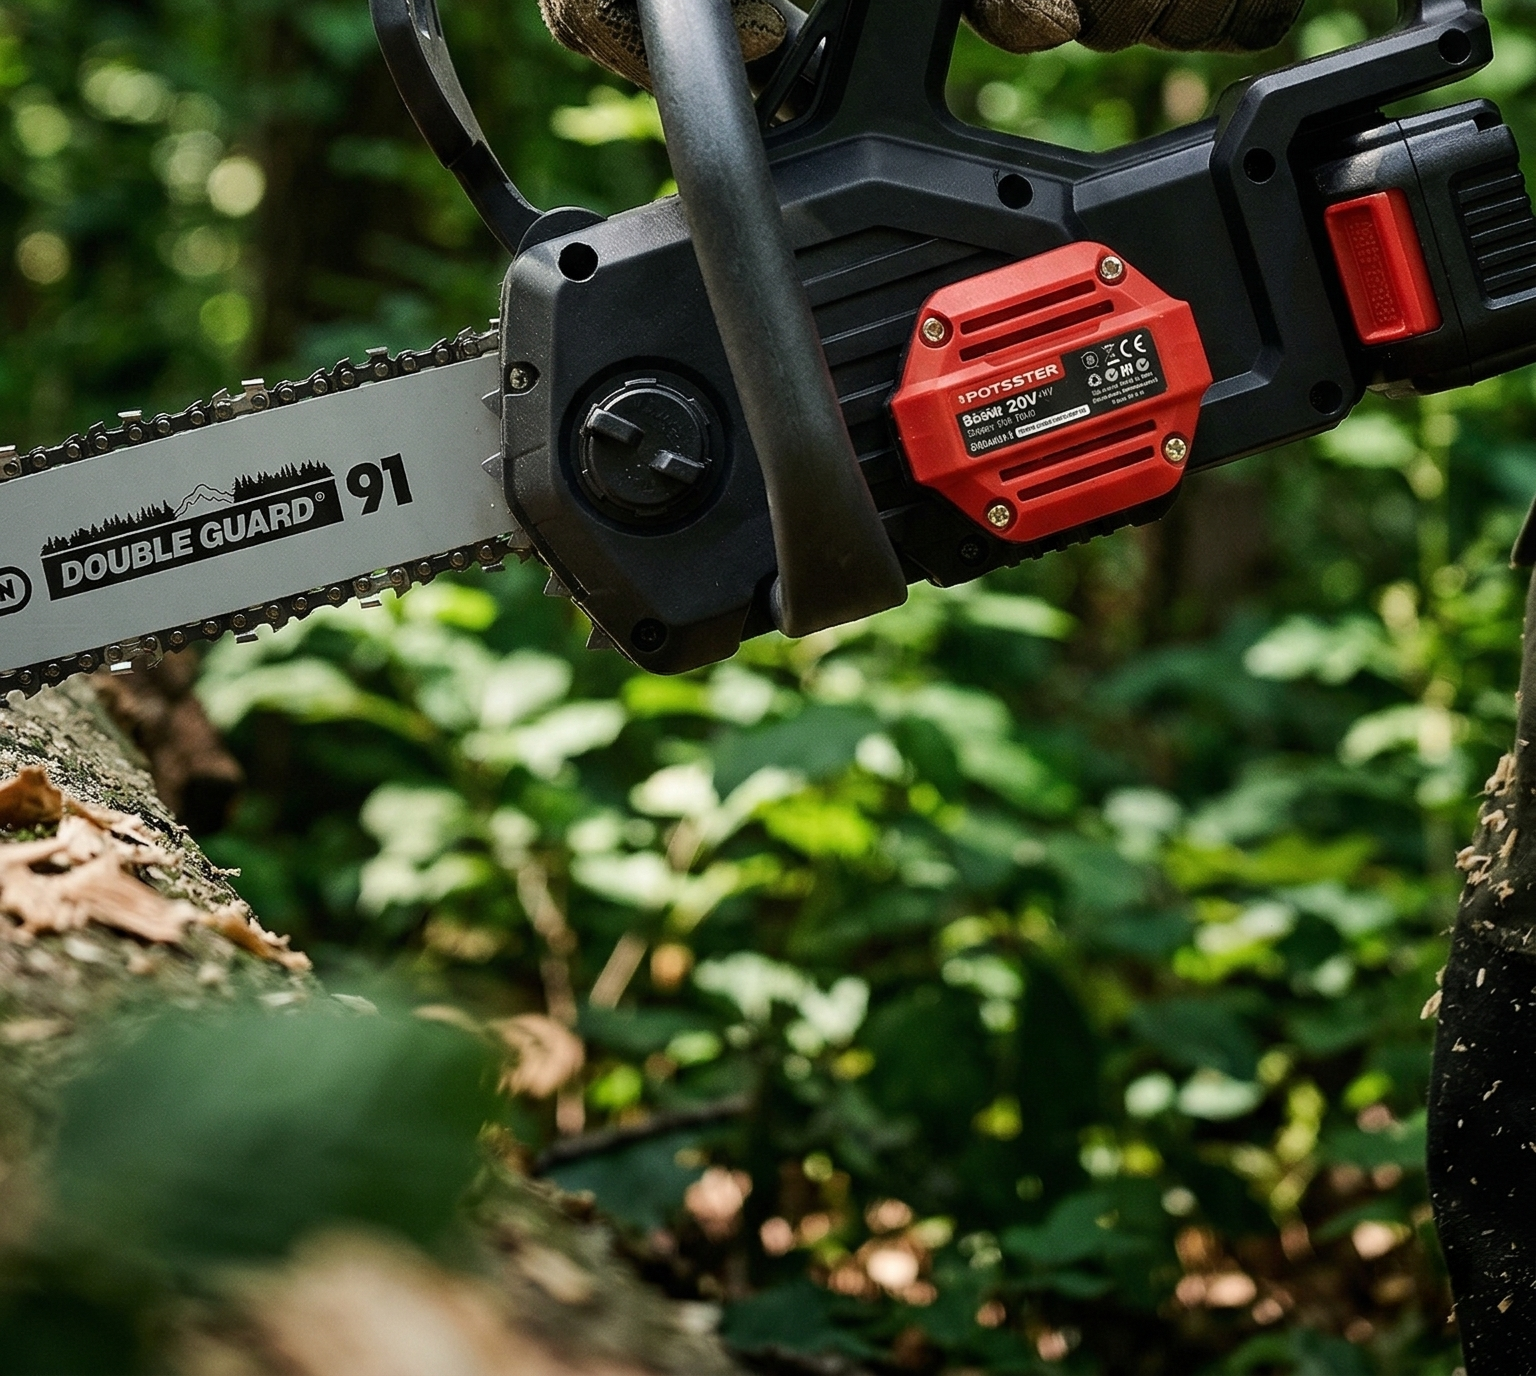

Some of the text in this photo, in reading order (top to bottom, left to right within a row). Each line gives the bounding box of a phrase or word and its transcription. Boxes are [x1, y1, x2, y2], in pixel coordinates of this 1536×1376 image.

[1006, 391, 1037, 414] 20V
[61, 453, 413, 589] DOUBLE GUARD 91
